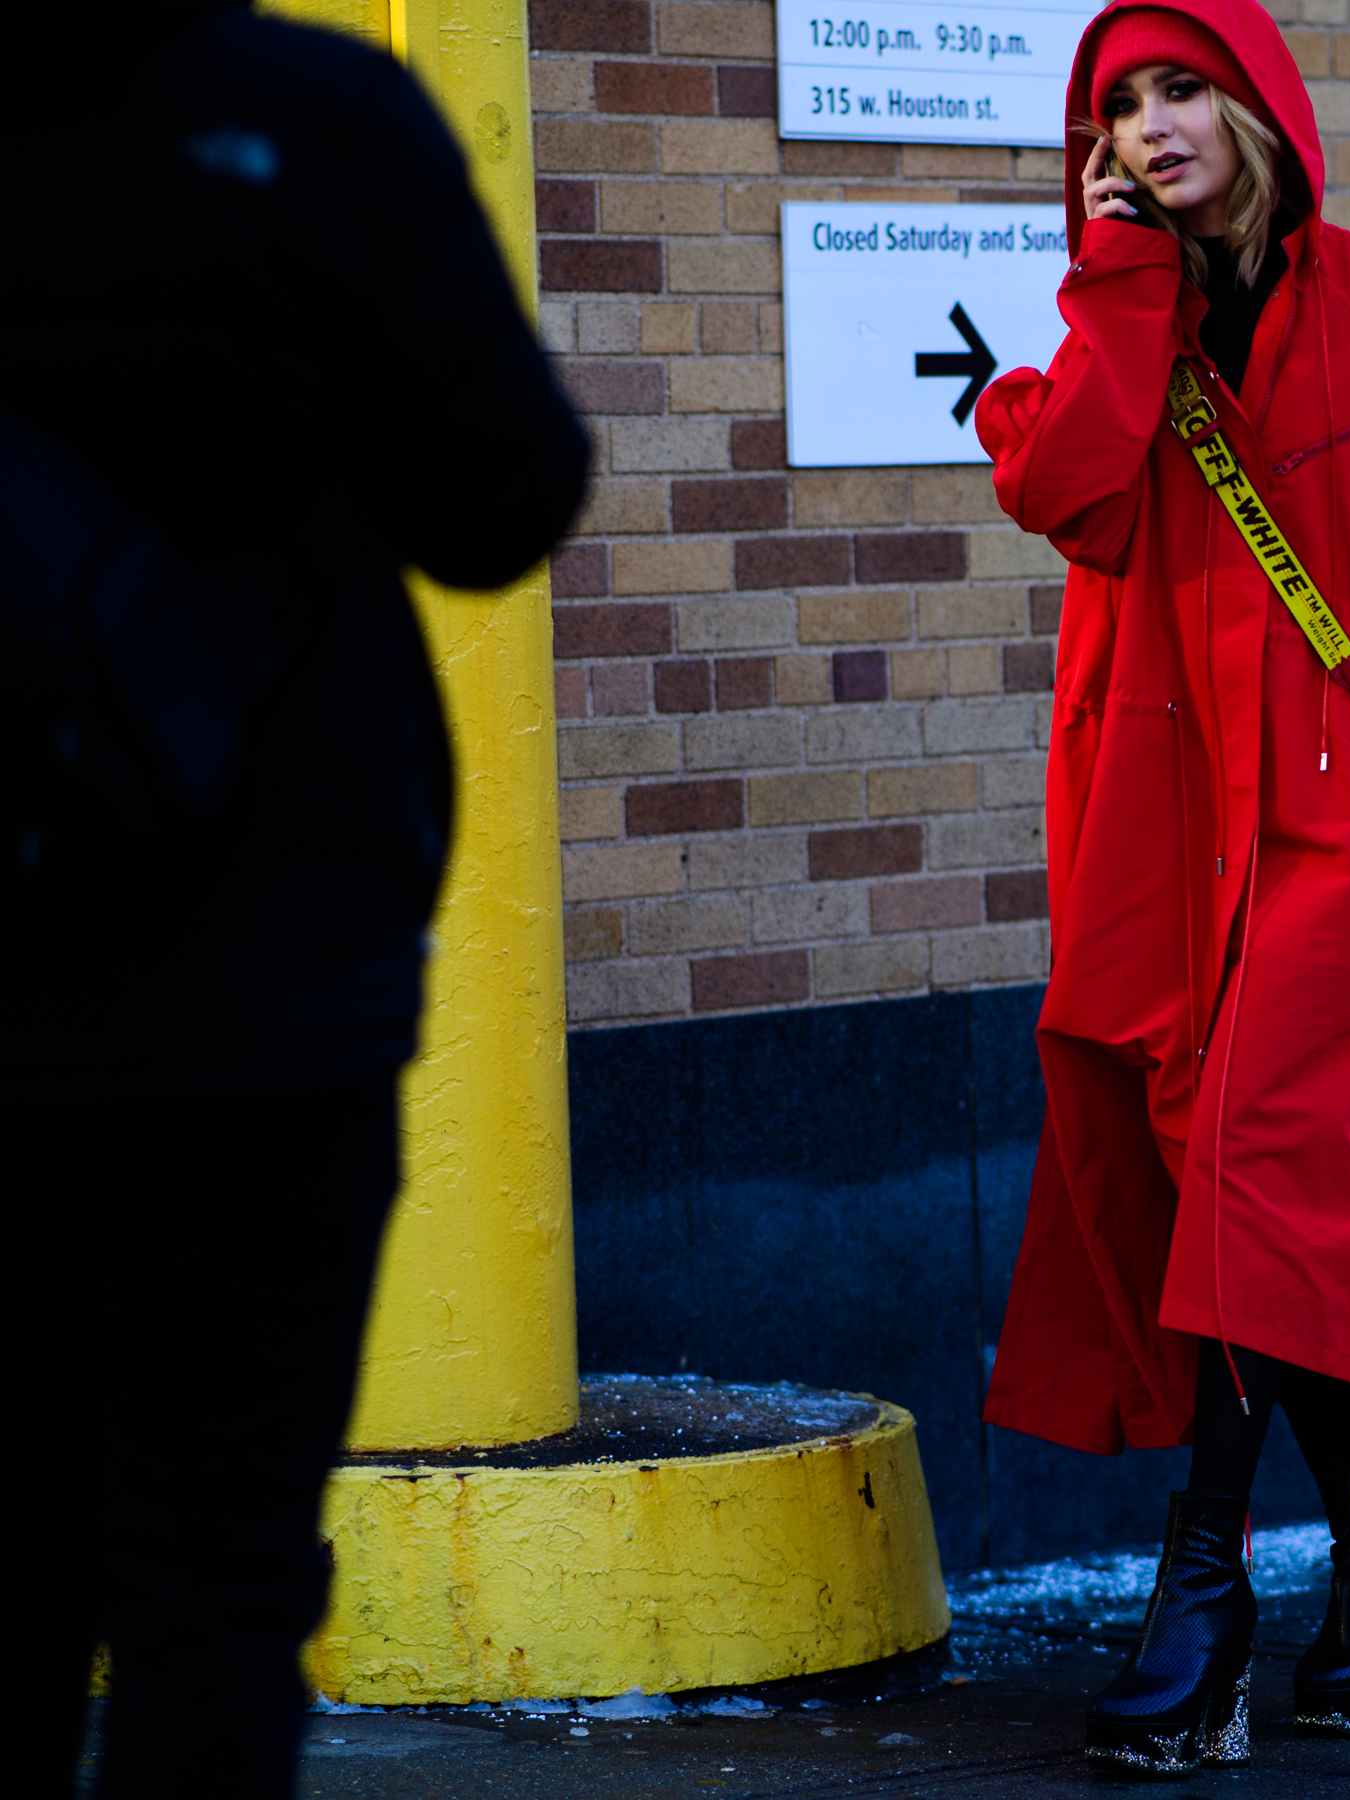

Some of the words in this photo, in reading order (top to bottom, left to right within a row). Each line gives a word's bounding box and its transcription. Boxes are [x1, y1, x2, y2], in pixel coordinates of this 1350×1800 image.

[810, 19, 870, 49] 12:00
[877, 29, 921, 57] p.m.
[936, 23, 982, 53] 9:30
[989, 34, 1031, 61] p.m.
[811, 86, 851, 115] 315
[858, 95, 881, 116] w.
[888, 89, 968, 119] Houston
[974, 96, 998, 120] st.
[812, 222, 878, 251] Closed
[885, 222, 972, 259] Saturday
[979, 224, 1014, 252] and
[1308, 619, 1330, 652] Weight
[1319, 614, 1344, 651] WILL
